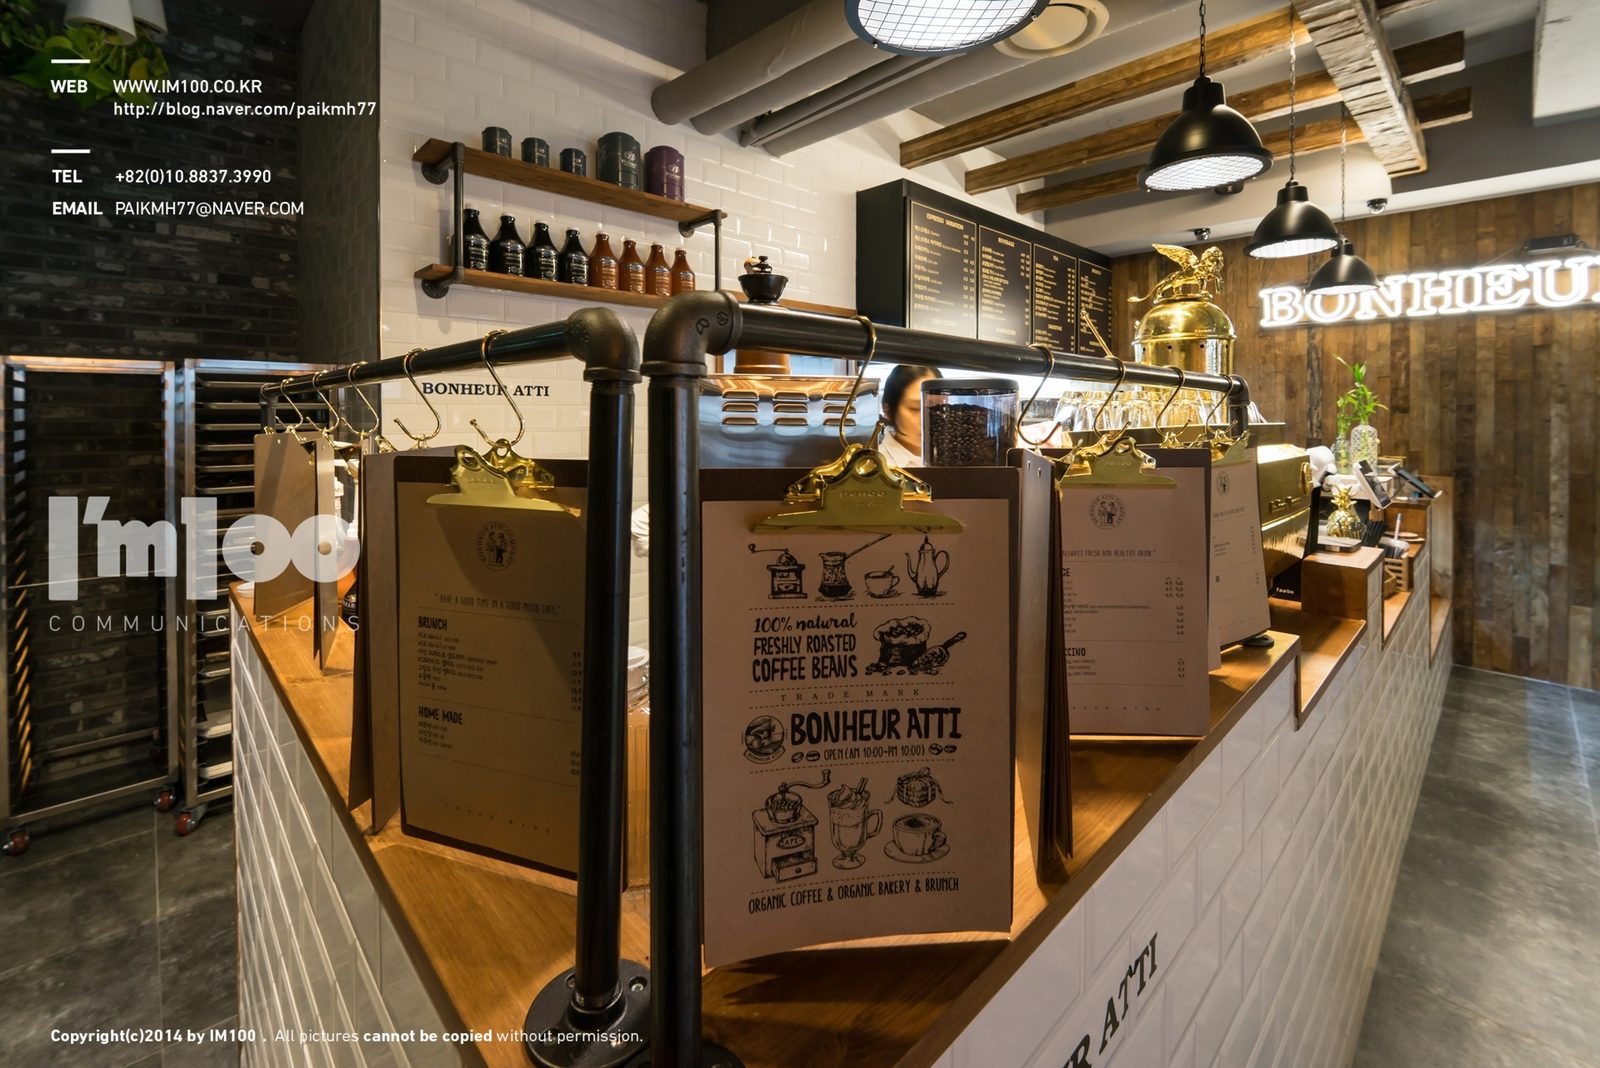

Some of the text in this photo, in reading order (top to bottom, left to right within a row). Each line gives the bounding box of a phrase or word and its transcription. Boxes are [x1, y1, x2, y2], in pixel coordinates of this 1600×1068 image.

[1259, 256, 1600, 328] BONHEU
[421, 382, 550, 397] BONHEUR ATTI
[418, 615, 447, 631] BRUNCH
[753, 612, 858, 633] 100% natural
[754, 633, 857, 656] FRESHLY ROASTED
[752, 654, 858, 682] COFFEE BEANS
[780, 688, 920, 702] TRADE MARK
[418, 705, 464, 725] HOME MADE
[790, 707, 962, 746] BONHEUR ATTI
[823, 748, 844, 761] OPEN
[748, 876, 959, 914] ORGANIC COFFEE & ORGANIC BAKERY & BRUNCH
[1099, 931, 1158, 1056] ATTI
